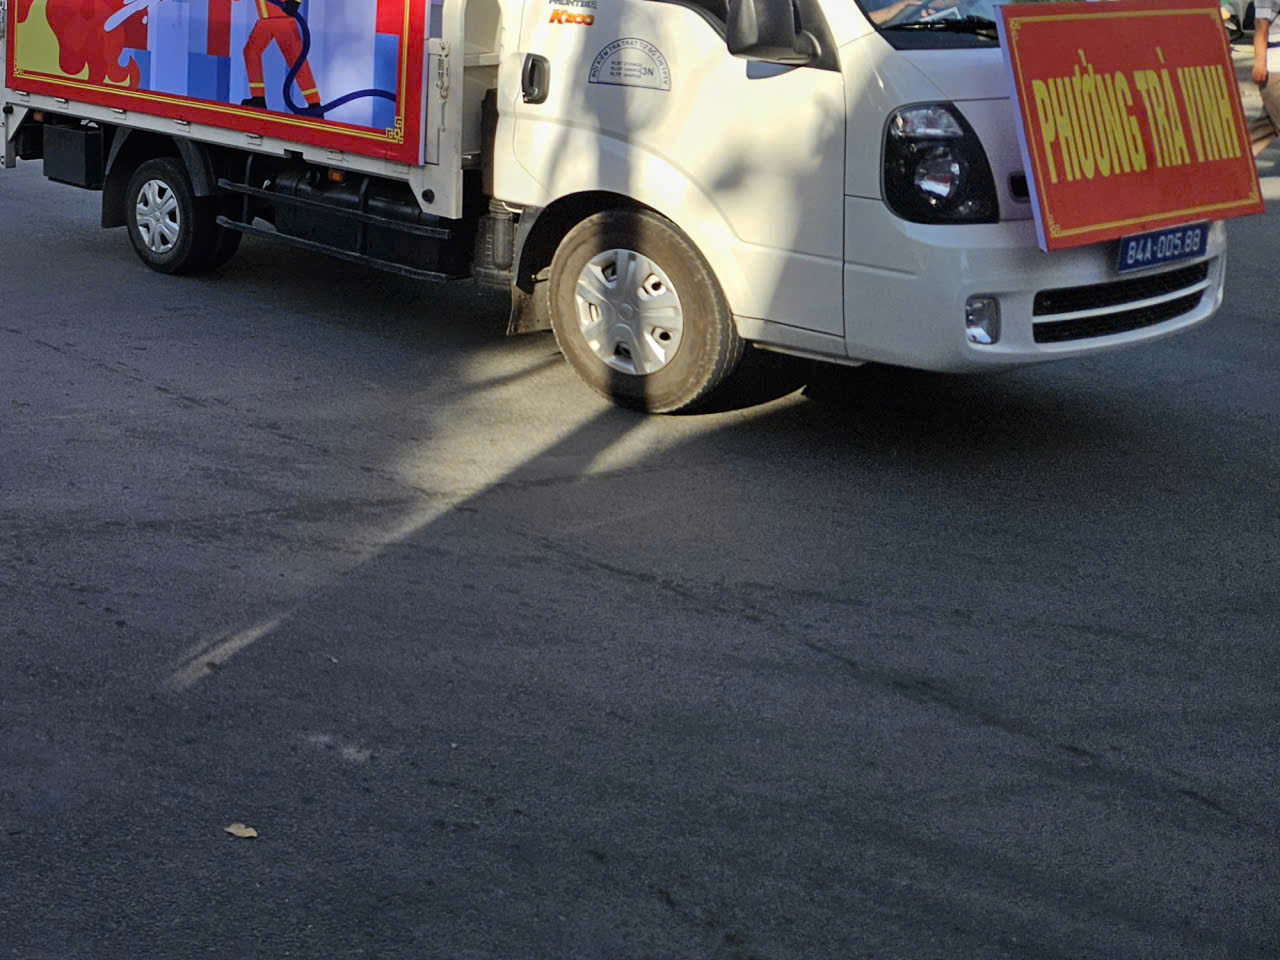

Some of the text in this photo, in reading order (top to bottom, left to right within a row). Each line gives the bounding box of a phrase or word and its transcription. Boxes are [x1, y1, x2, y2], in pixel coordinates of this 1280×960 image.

[1032, 46, 1242, 184] PHƯỜNG TRÀ VINH
